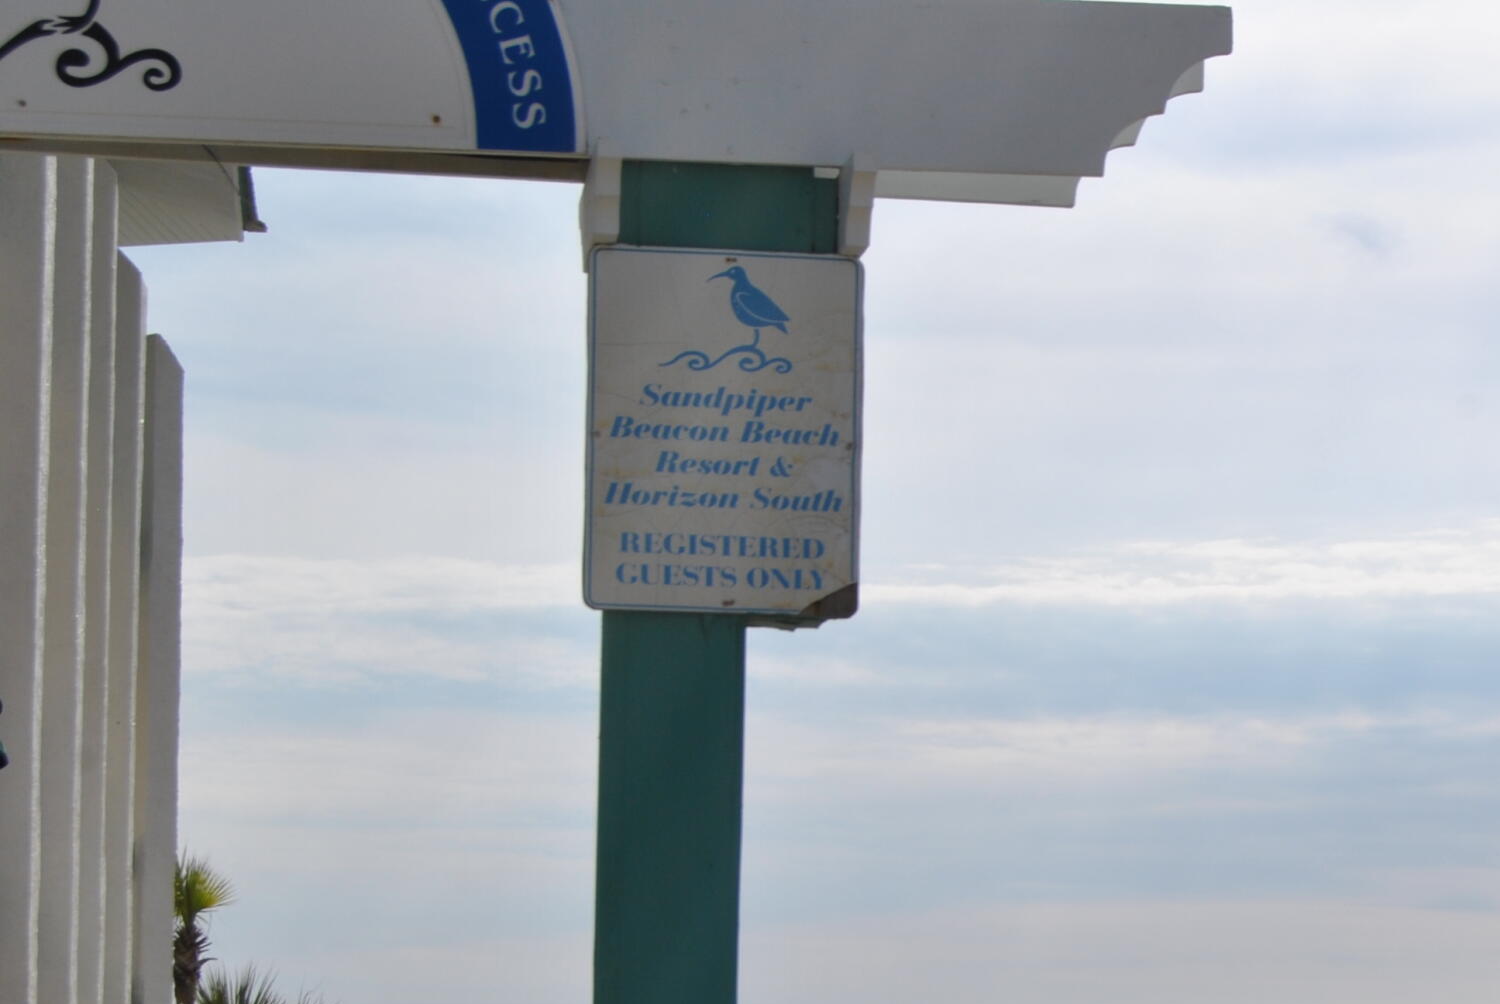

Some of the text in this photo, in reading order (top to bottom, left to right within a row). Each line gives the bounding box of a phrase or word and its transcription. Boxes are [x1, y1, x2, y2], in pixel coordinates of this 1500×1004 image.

[480, 0, 547, 129] CESS
[639, 384, 812, 417] Sandpiper
[609, 416, 840, 447] Beacon Beach
[654, 451, 793, 477] Resort &
[603, 482, 843, 513] Horizon South
[619, 532, 825, 560] REGISTERED
[615, 562, 824, 591] GUESTS ONLY
